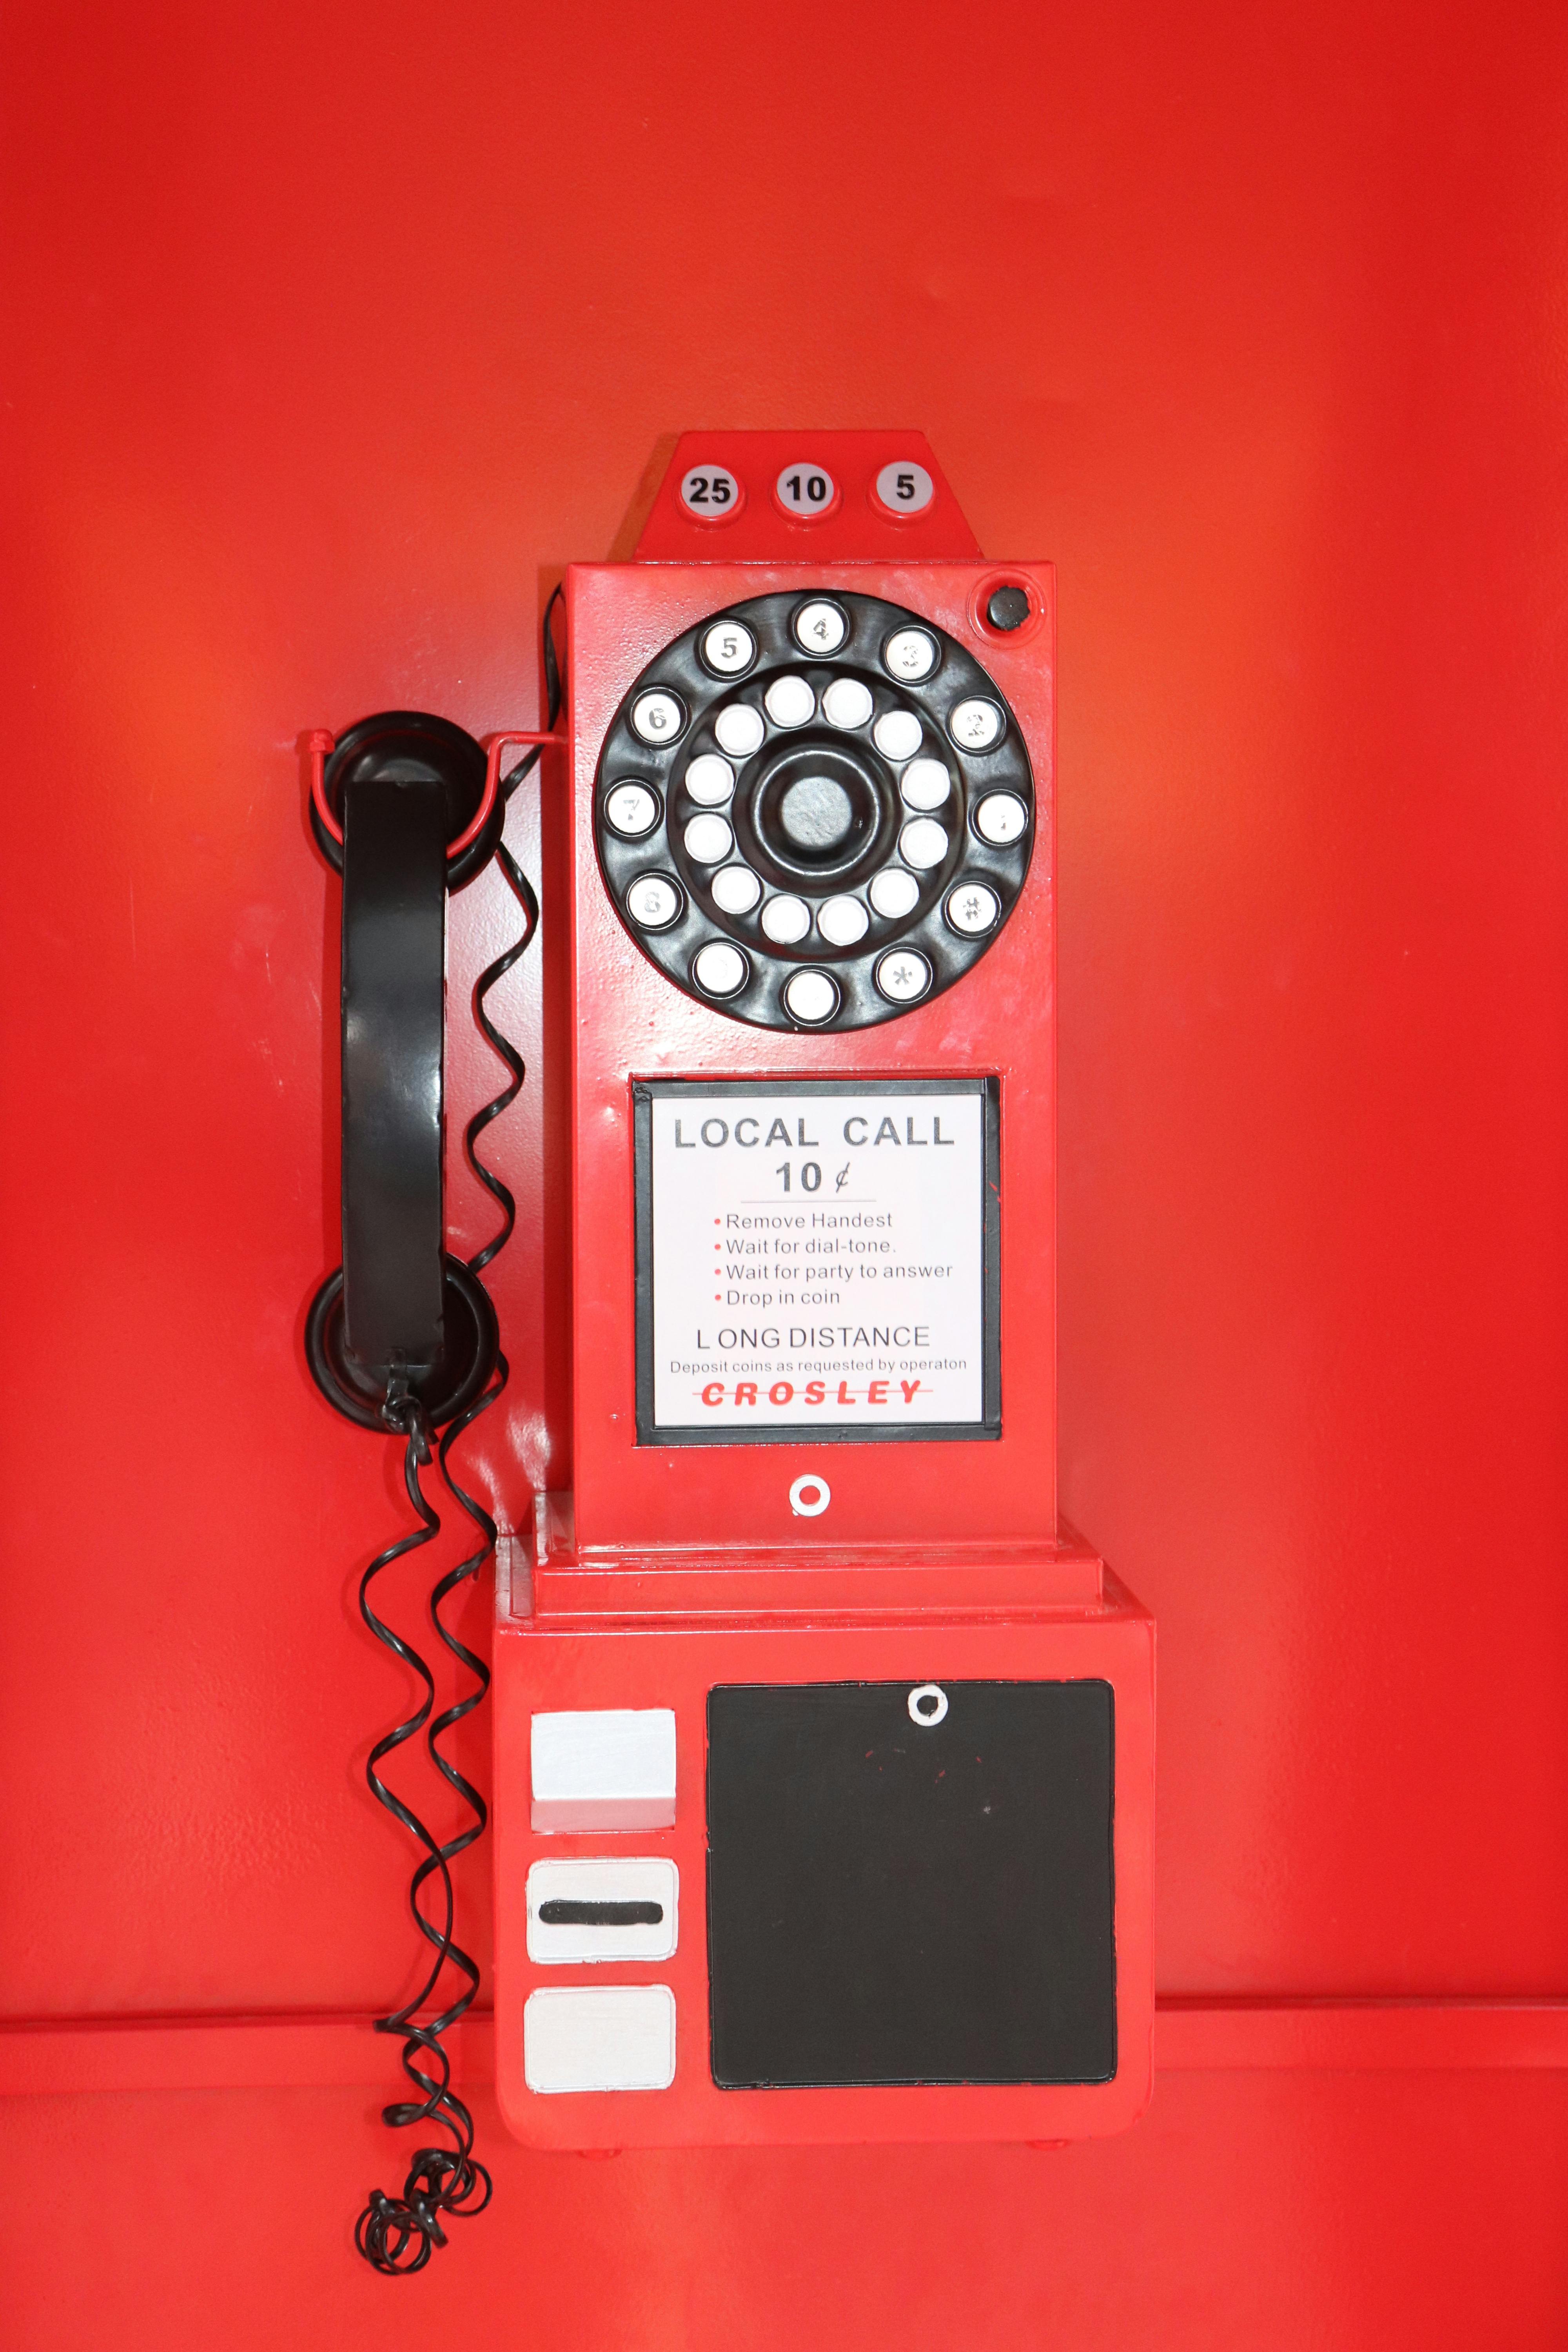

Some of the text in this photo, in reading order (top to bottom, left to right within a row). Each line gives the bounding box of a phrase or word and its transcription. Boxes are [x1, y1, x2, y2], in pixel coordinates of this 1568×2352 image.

[690, 477, 731, 504] 25
[787, 475, 826, 502] 10
[897, 474, 915, 500] 5
[813, 619, 829, 640] 4
[721, 637, 737, 659] 5
[649, 708, 666, 730] 6
[675, 1117, 954, 1148] LOCAL CALL
[776, 1162, 822, 1192] 10
[727, 1213, 891, 1229] Remove Handest
[726, 1240, 768, 1254] Wait
[775, 1239, 799, 1253] for
[727, 1265, 952, 1282] Wait for party to answer
[728, 1289, 839, 1308] Drop in coin
[698, 1327, 929, 1348] LONG DISTANCE
[671, 1359, 966, 1376] Deposit coins as requested by operaton
[702, 1380, 920, 1406] CROSLEY
